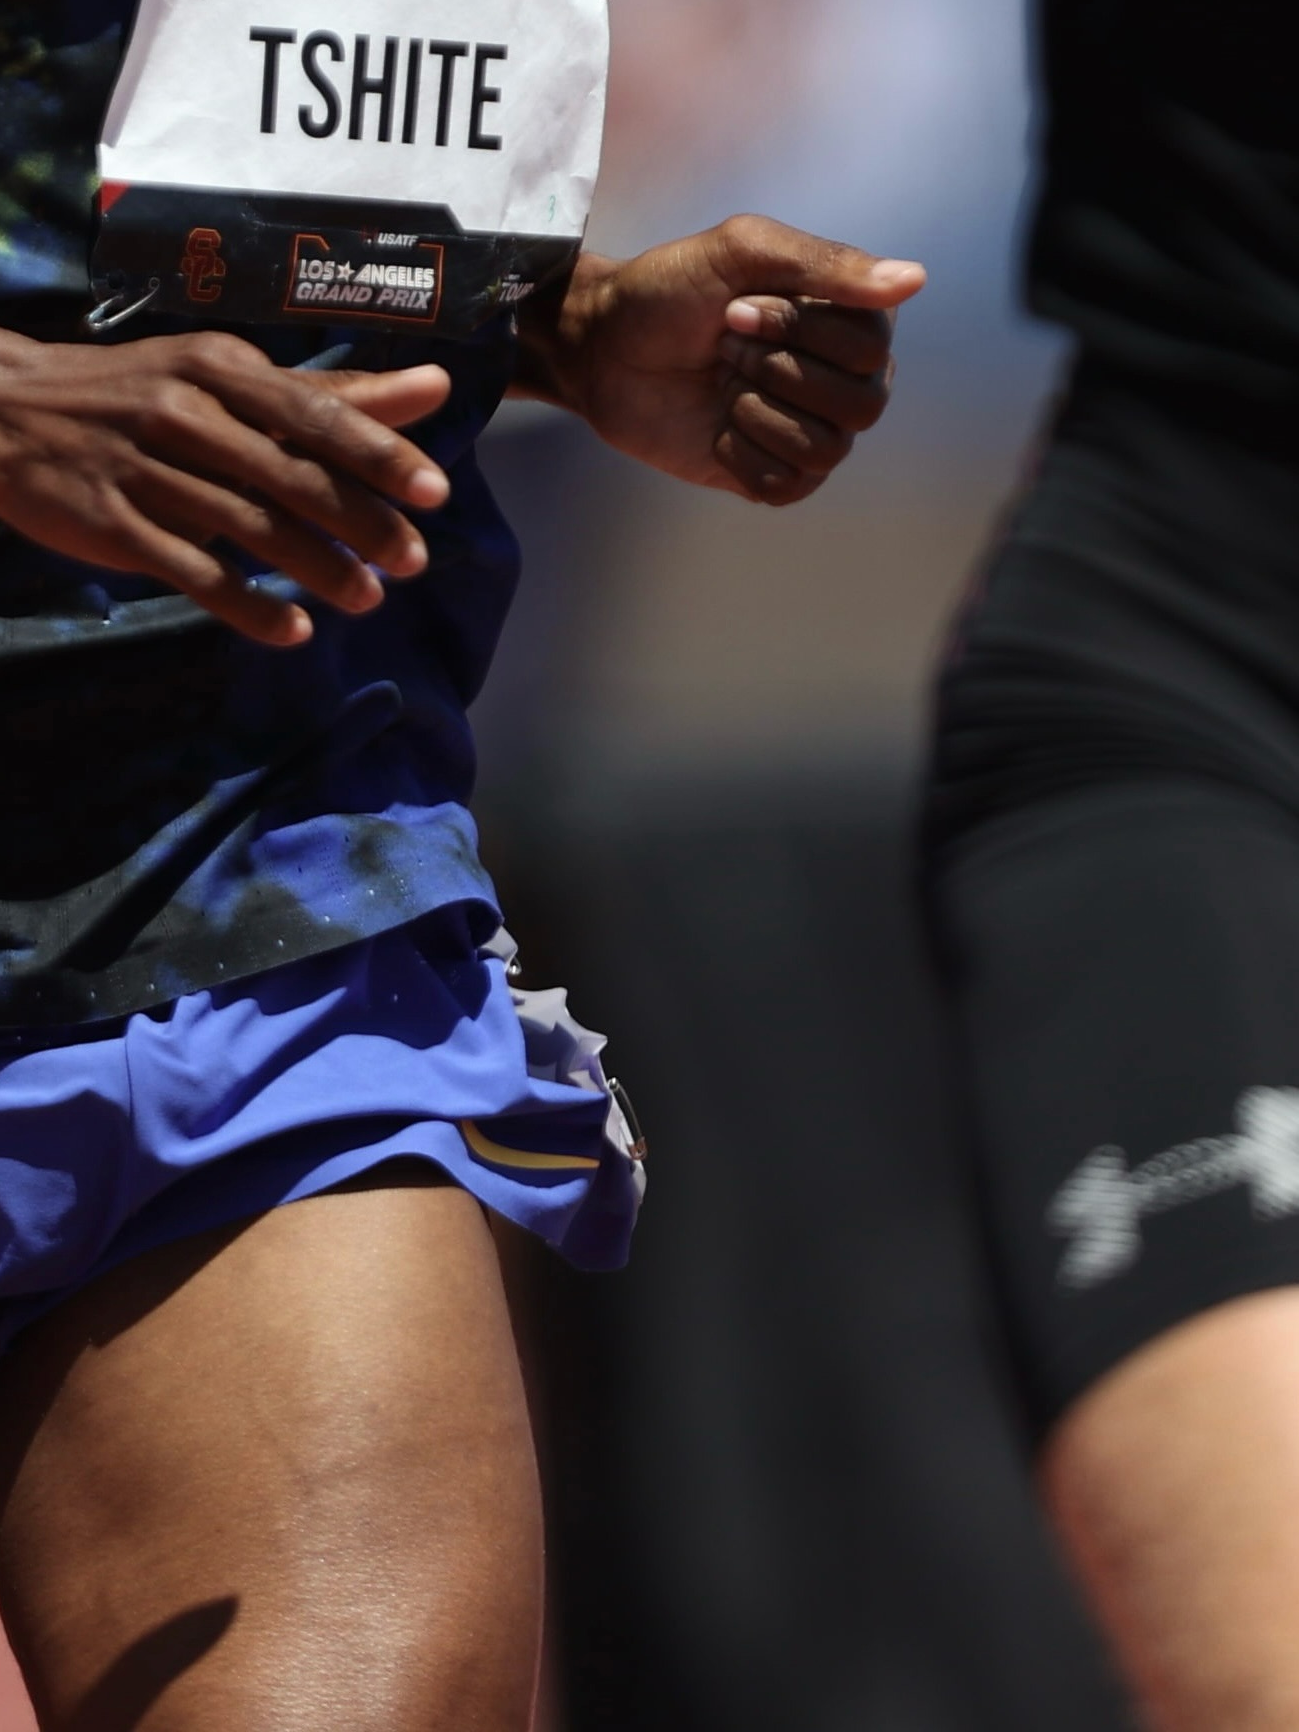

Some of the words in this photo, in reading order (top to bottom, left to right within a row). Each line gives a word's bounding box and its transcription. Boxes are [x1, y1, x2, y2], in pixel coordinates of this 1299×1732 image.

[249, 25, 508, 150] TSHITE
[377, 232, 419, 247] USATF
[298, 258, 336, 281] LOS
[352, 263, 435, 289] ANGELES
[295, 281, 373, 303] GRAND
[376, 288, 433, 309] PRIX
